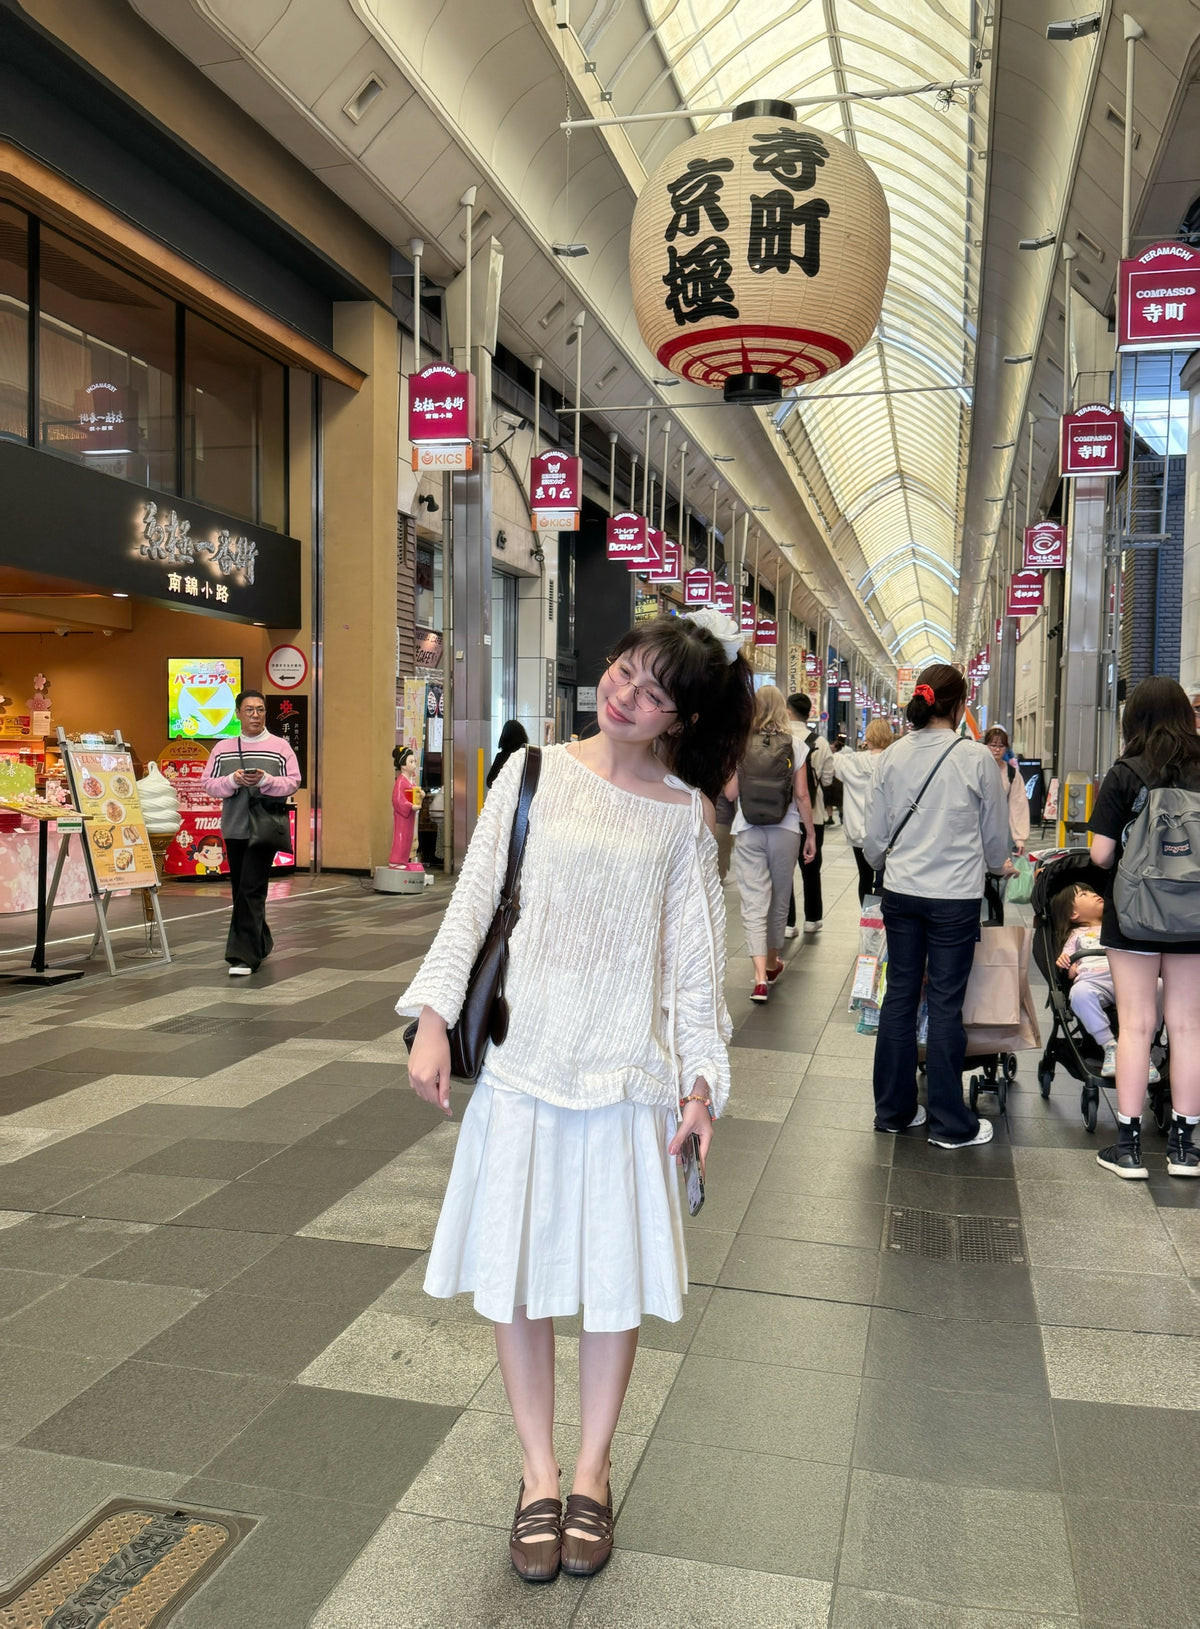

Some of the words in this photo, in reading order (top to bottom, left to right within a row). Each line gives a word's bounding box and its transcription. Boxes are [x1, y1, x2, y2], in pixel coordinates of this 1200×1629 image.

[748, 126, 830, 278] 寺町
[662, 157, 740, 326] 京極
[1138, 246, 1194, 265] TERAMACHI
[1136, 286, 1196, 300] COMPASSO
[1142, 302, 1187, 324] 寺町
[421, 366, 457, 379] TERAMACHI
[1074, 404, 1113, 418] TERAMACHI
[1073, 434, 1113, 443] COMPASSO
[434, 452, 463, 465] KICS
[1077, 445, 1108, 460] 寺町
[550, 517, 572, 527] KICS
[167, 571, 230, 604] 南錦小路
